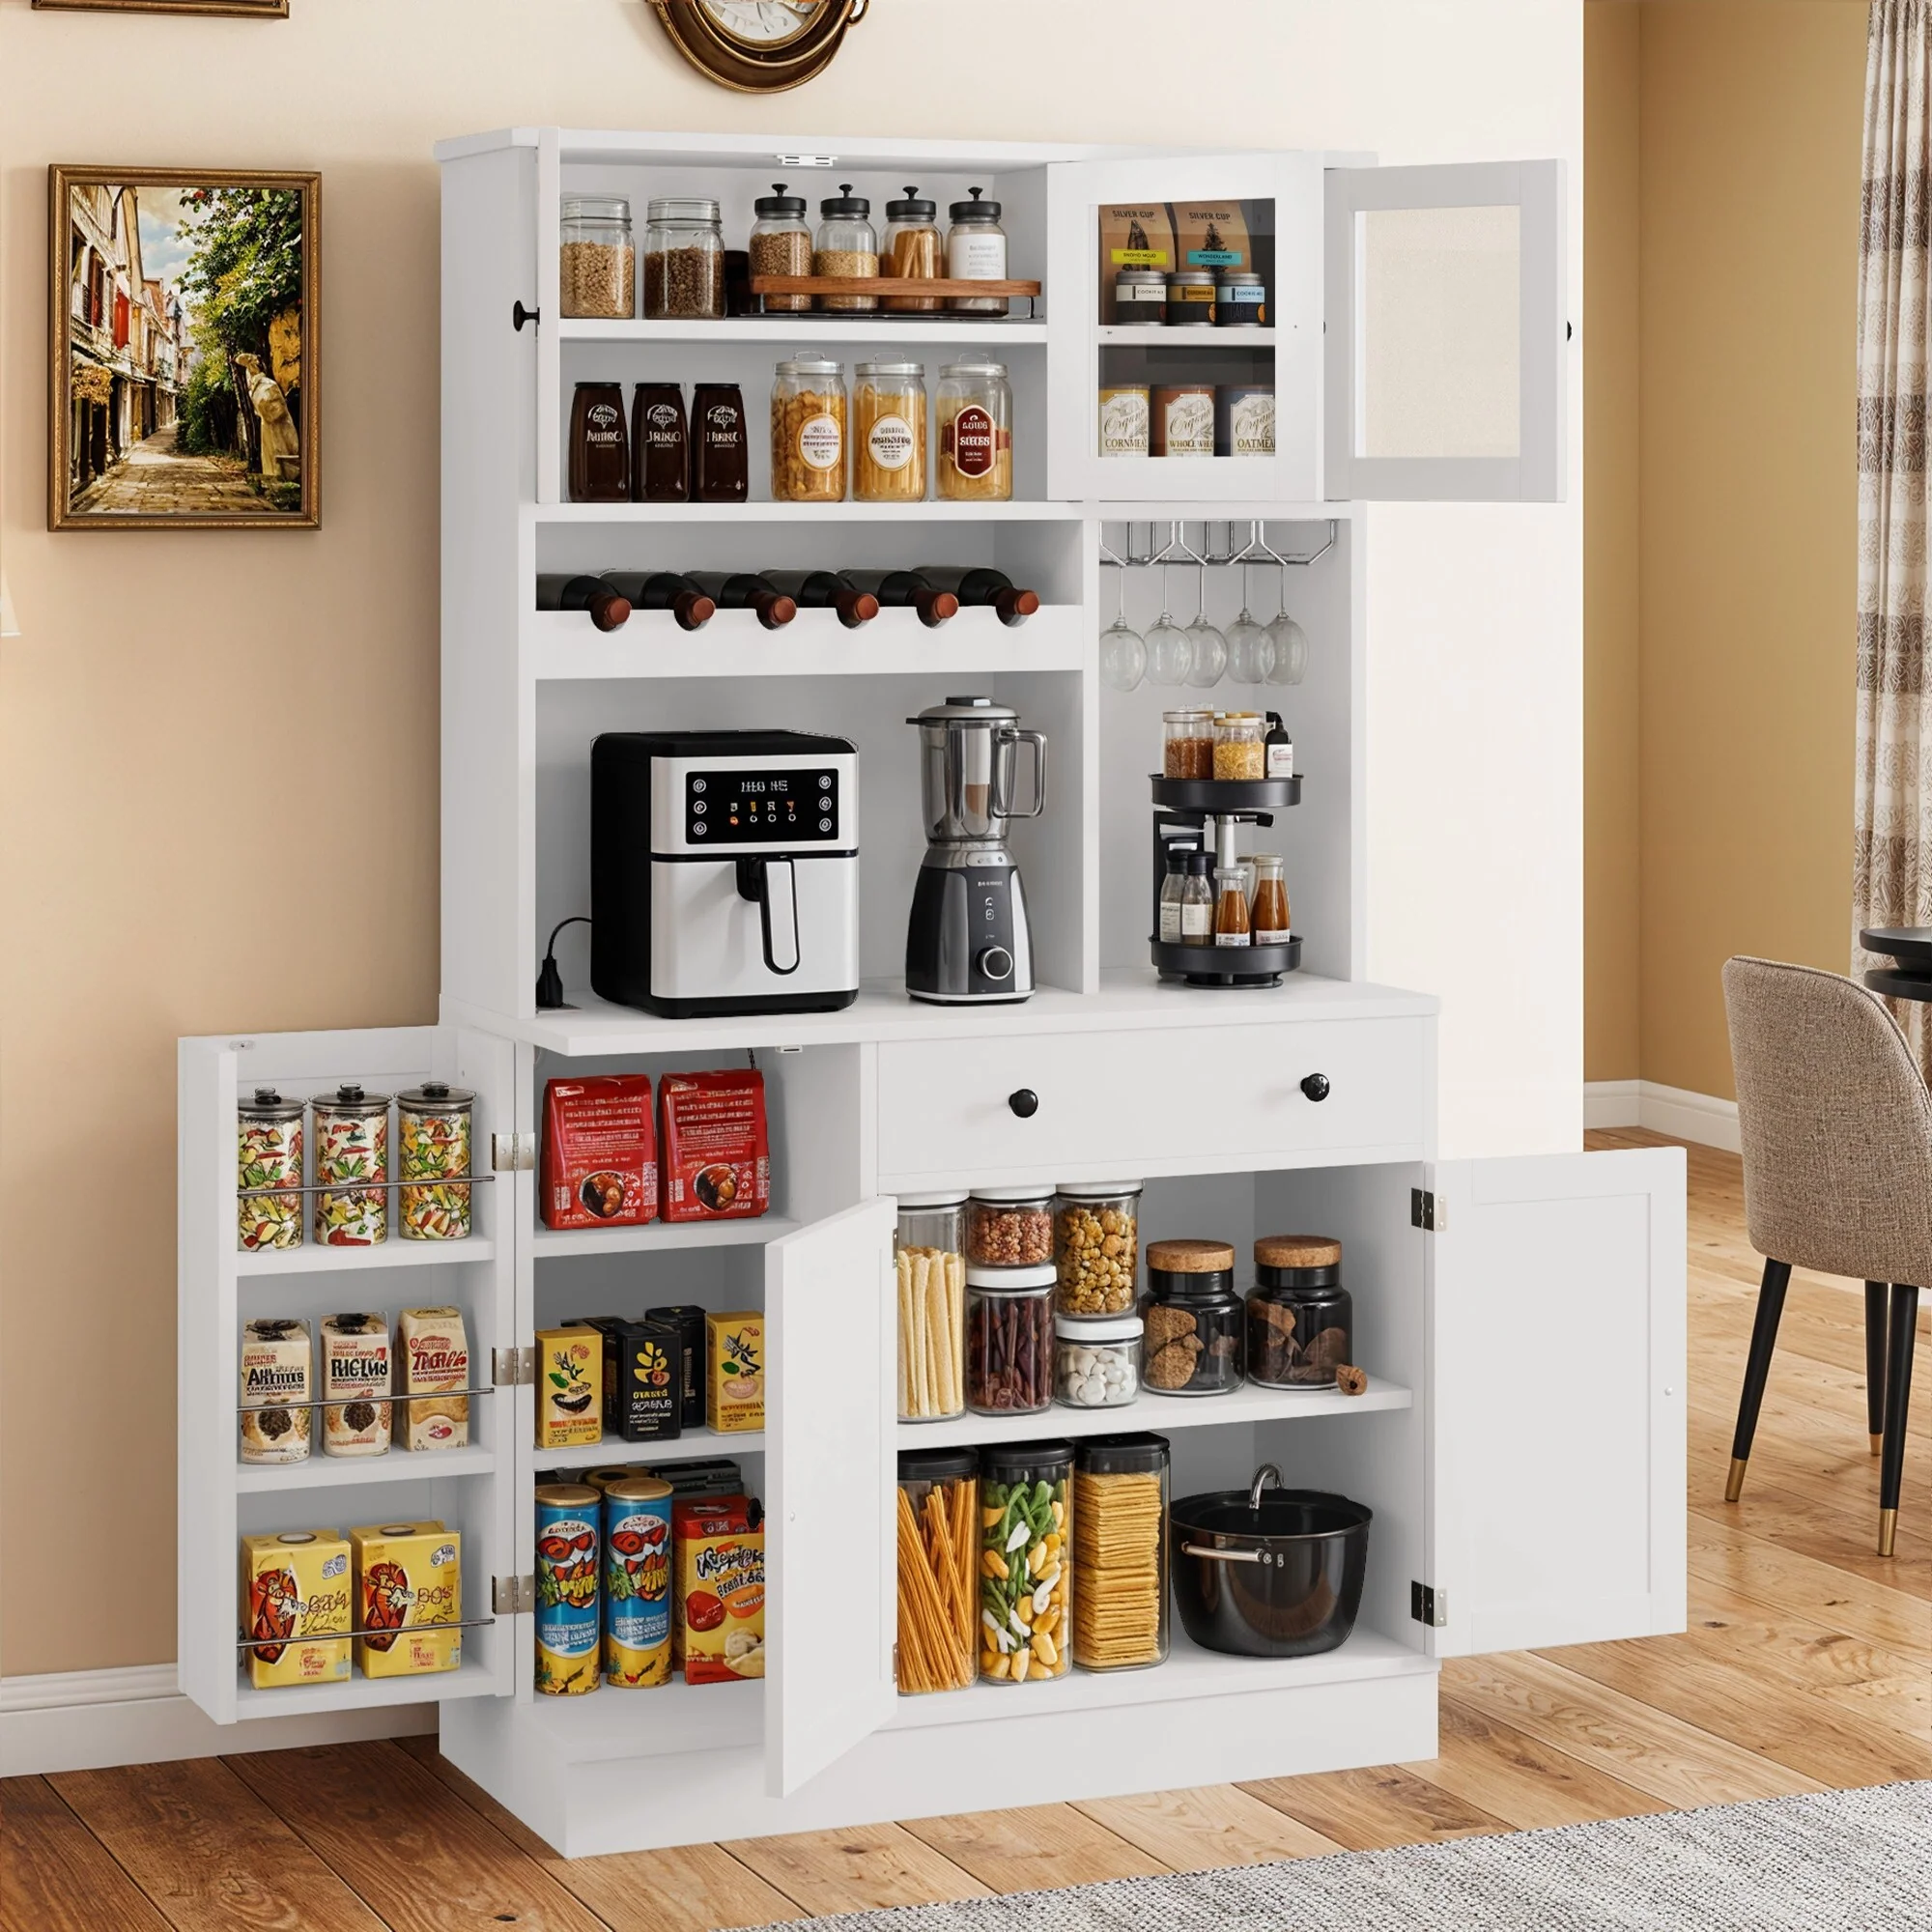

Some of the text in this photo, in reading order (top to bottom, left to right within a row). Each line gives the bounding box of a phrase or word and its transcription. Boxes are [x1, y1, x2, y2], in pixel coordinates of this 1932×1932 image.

[1112, 210, 1138, 218] SILVER
[1188, 212, 1214, 220] SILVER
[1169, 440, 1196, 448] WHOLE
